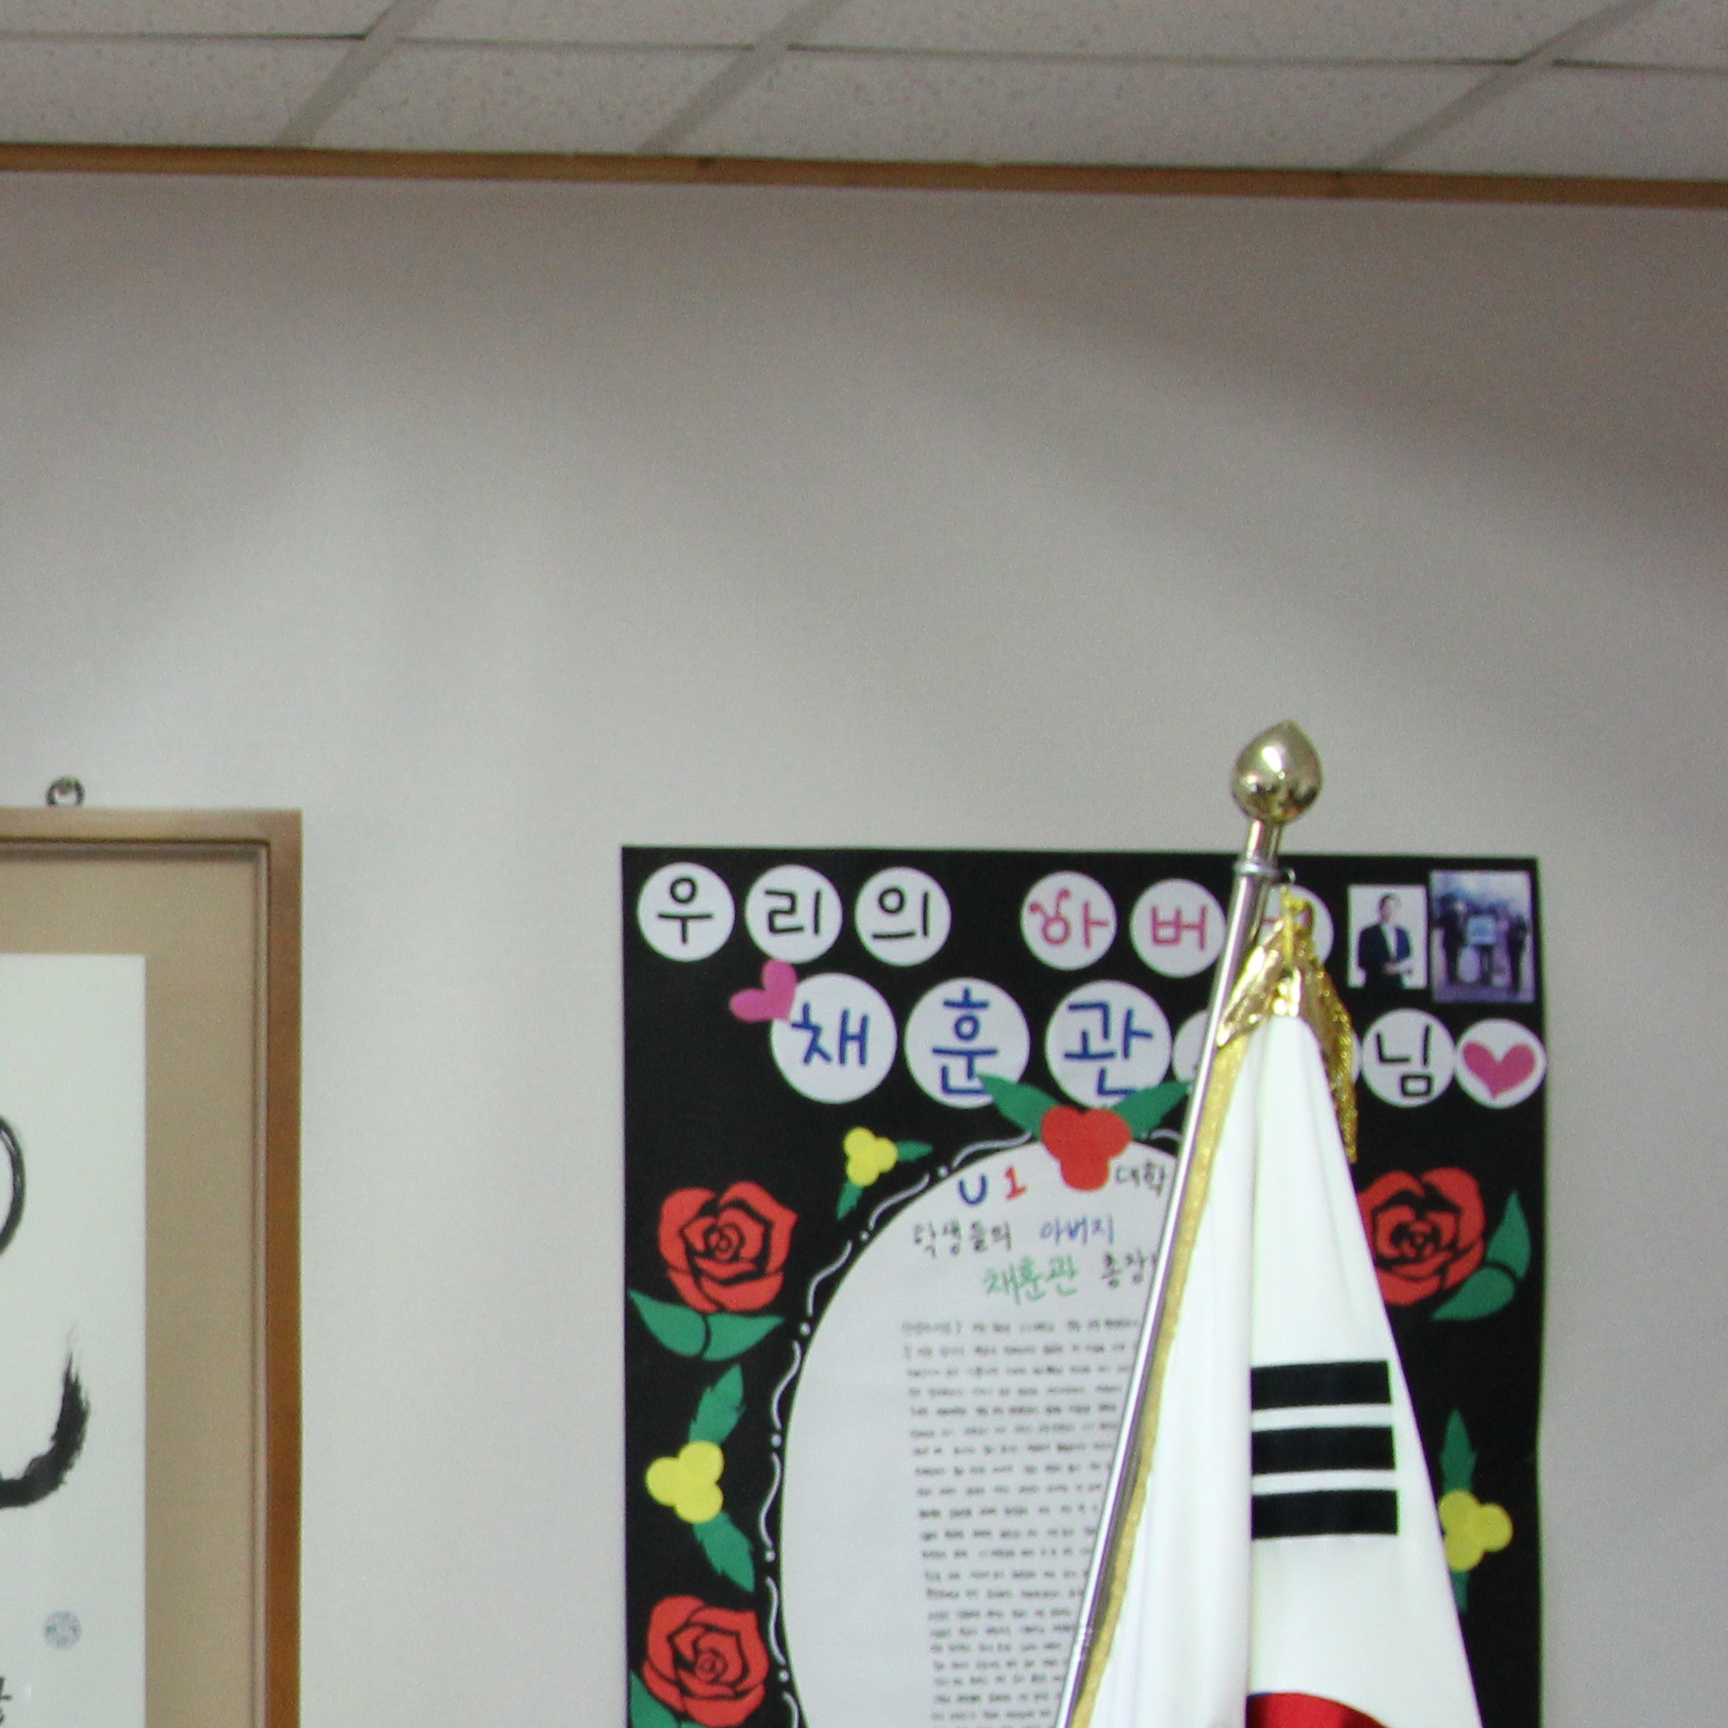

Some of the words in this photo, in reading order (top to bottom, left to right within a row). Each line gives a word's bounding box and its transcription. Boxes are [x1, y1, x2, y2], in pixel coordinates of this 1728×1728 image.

[662, 875, 932, 946] 우리의
[788, 987, 1160, 1100] 채훈관
[1039, 1213, 1115, 1246] 아버지
[983, 1255, 1079, 1305] 채훈관
[1101, 1249, 1158, 1290] 총장
